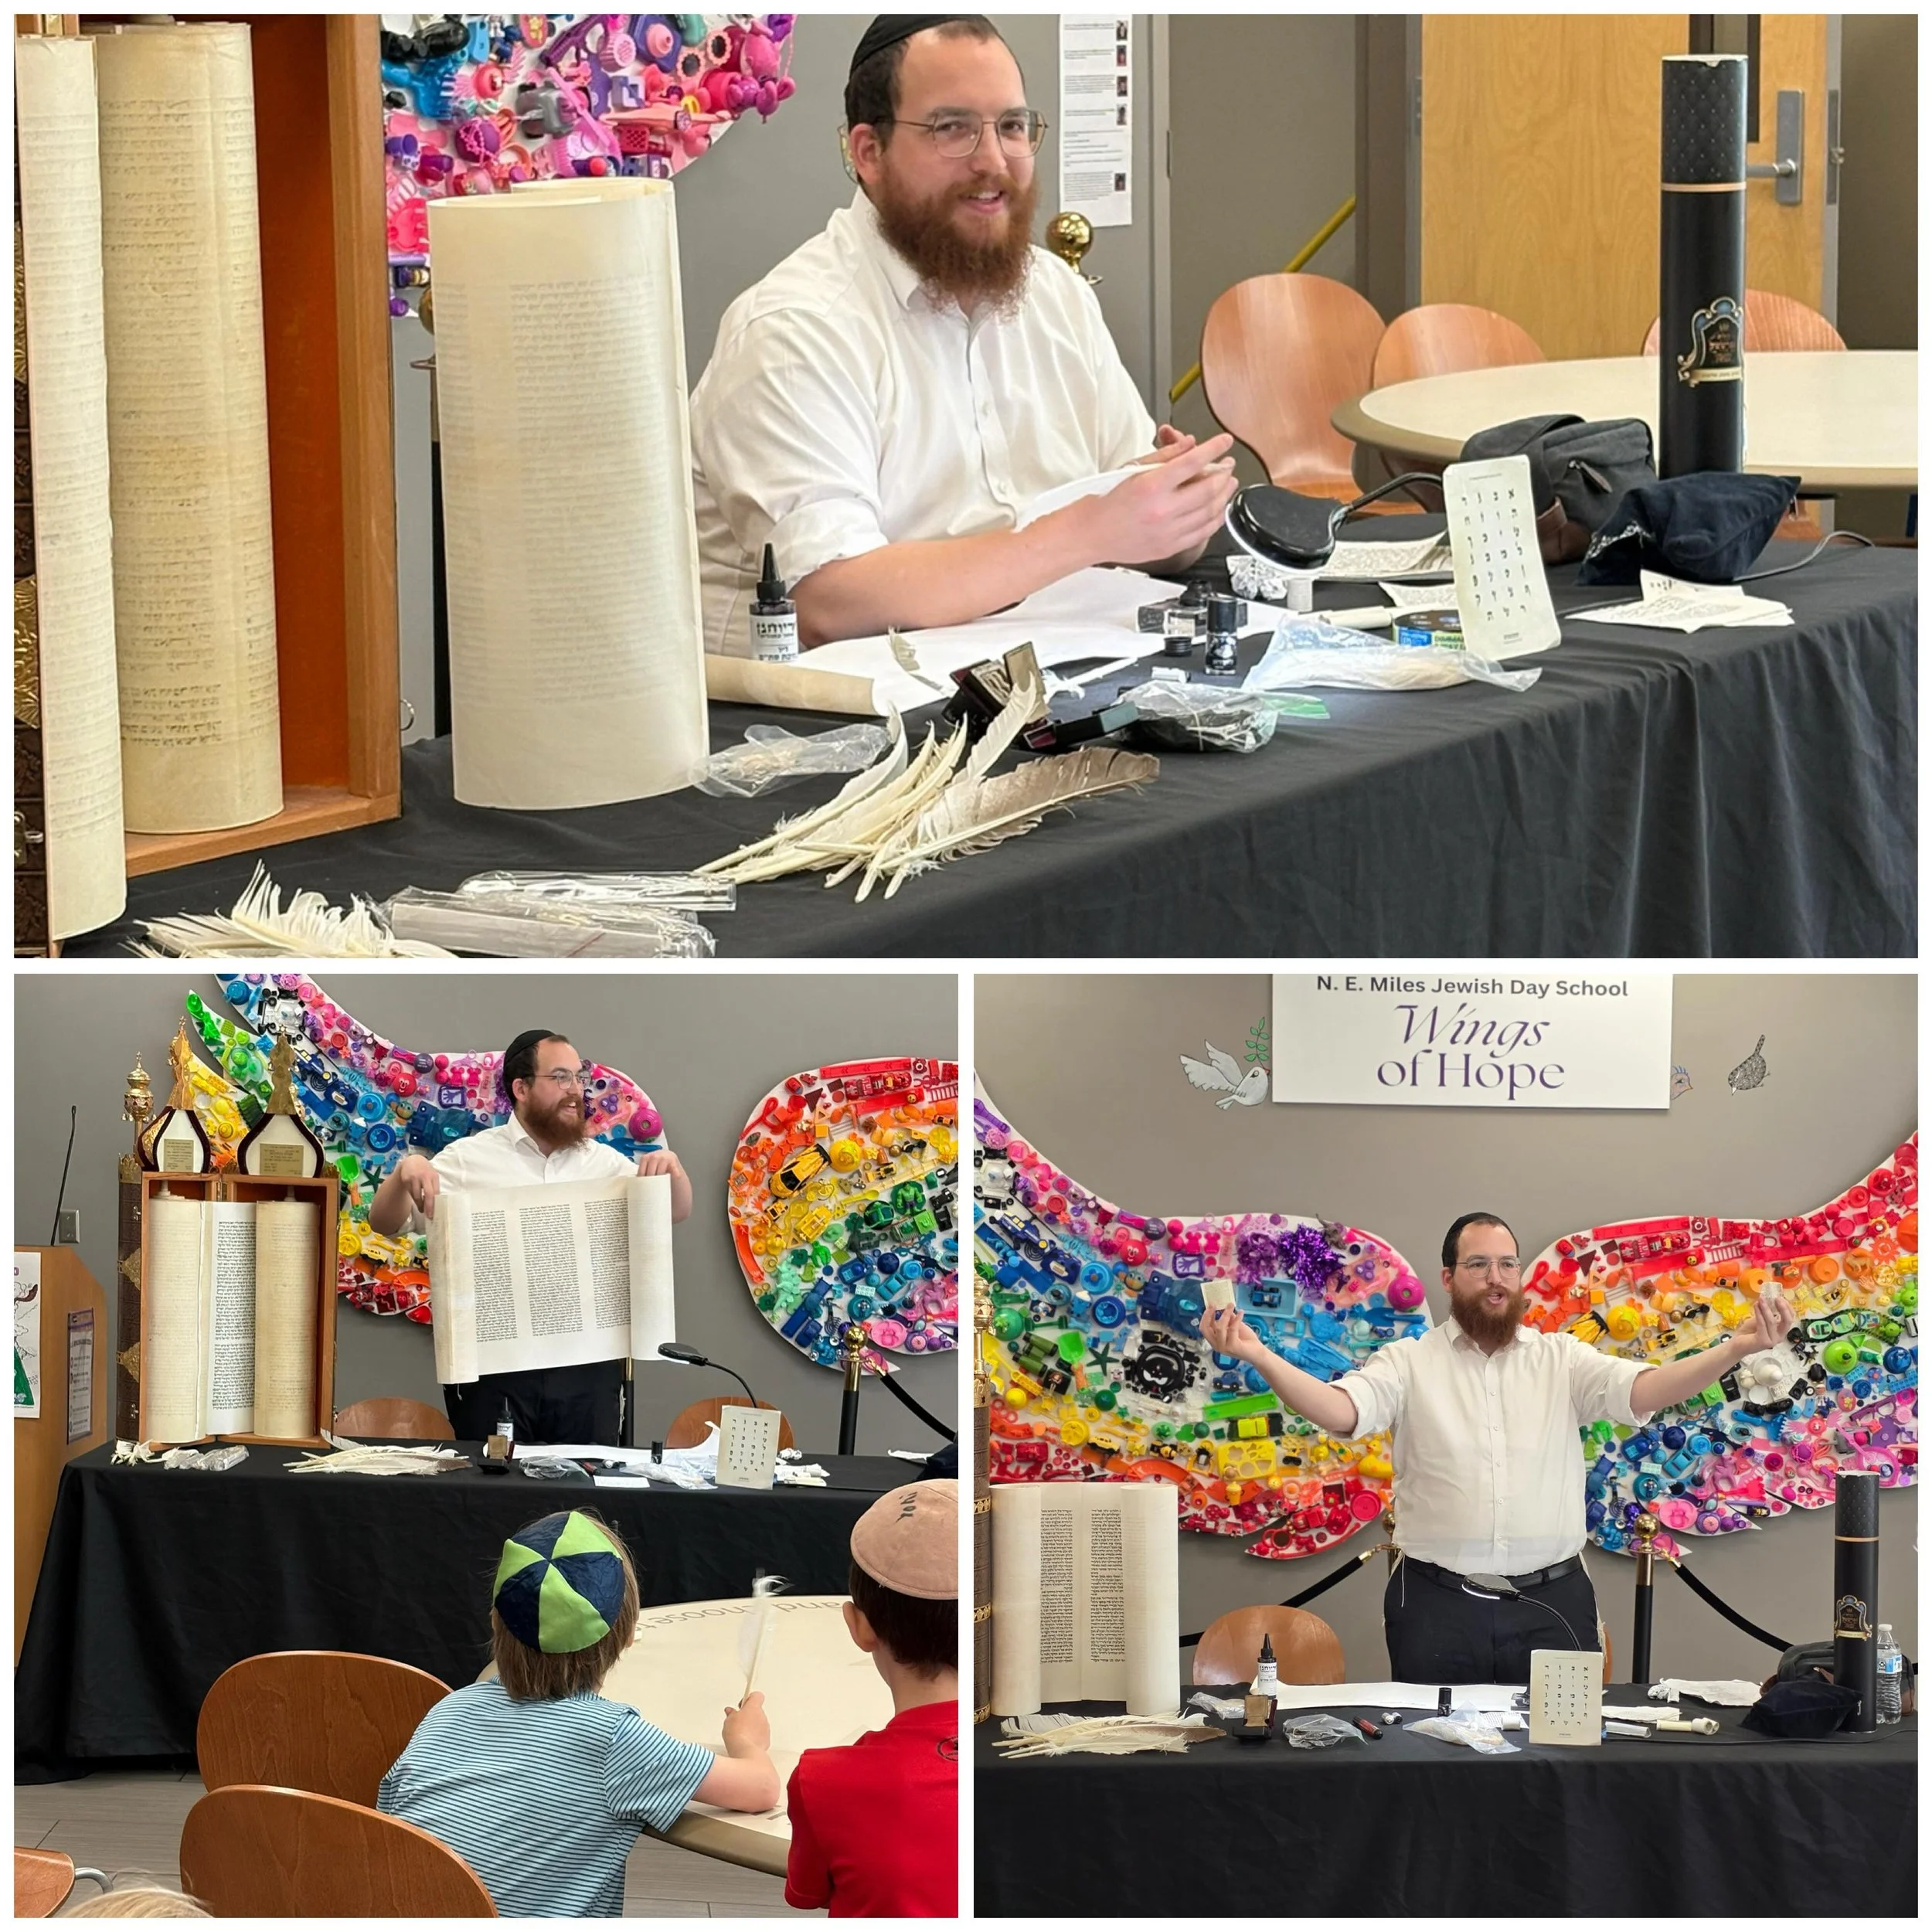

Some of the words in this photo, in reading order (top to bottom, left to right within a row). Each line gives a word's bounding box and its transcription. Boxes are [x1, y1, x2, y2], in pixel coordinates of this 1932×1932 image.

[1317, 975, 1338, 991] N.
[1345, 976, 1363, 992] E.
[1370, 976, 1426, 993] Miles
[1430, 978, 1503, 995] Jewish
[1510, 979, 1550, 999] Day
[1556, 980, 1628, 997] School
[1393, 1002, 1550, 1059] Wings
[1377, 1049, 1433, 1087] of
[1437, 1053, 1565, 1101] Hope
[774, 1600, 842, 1613] and
